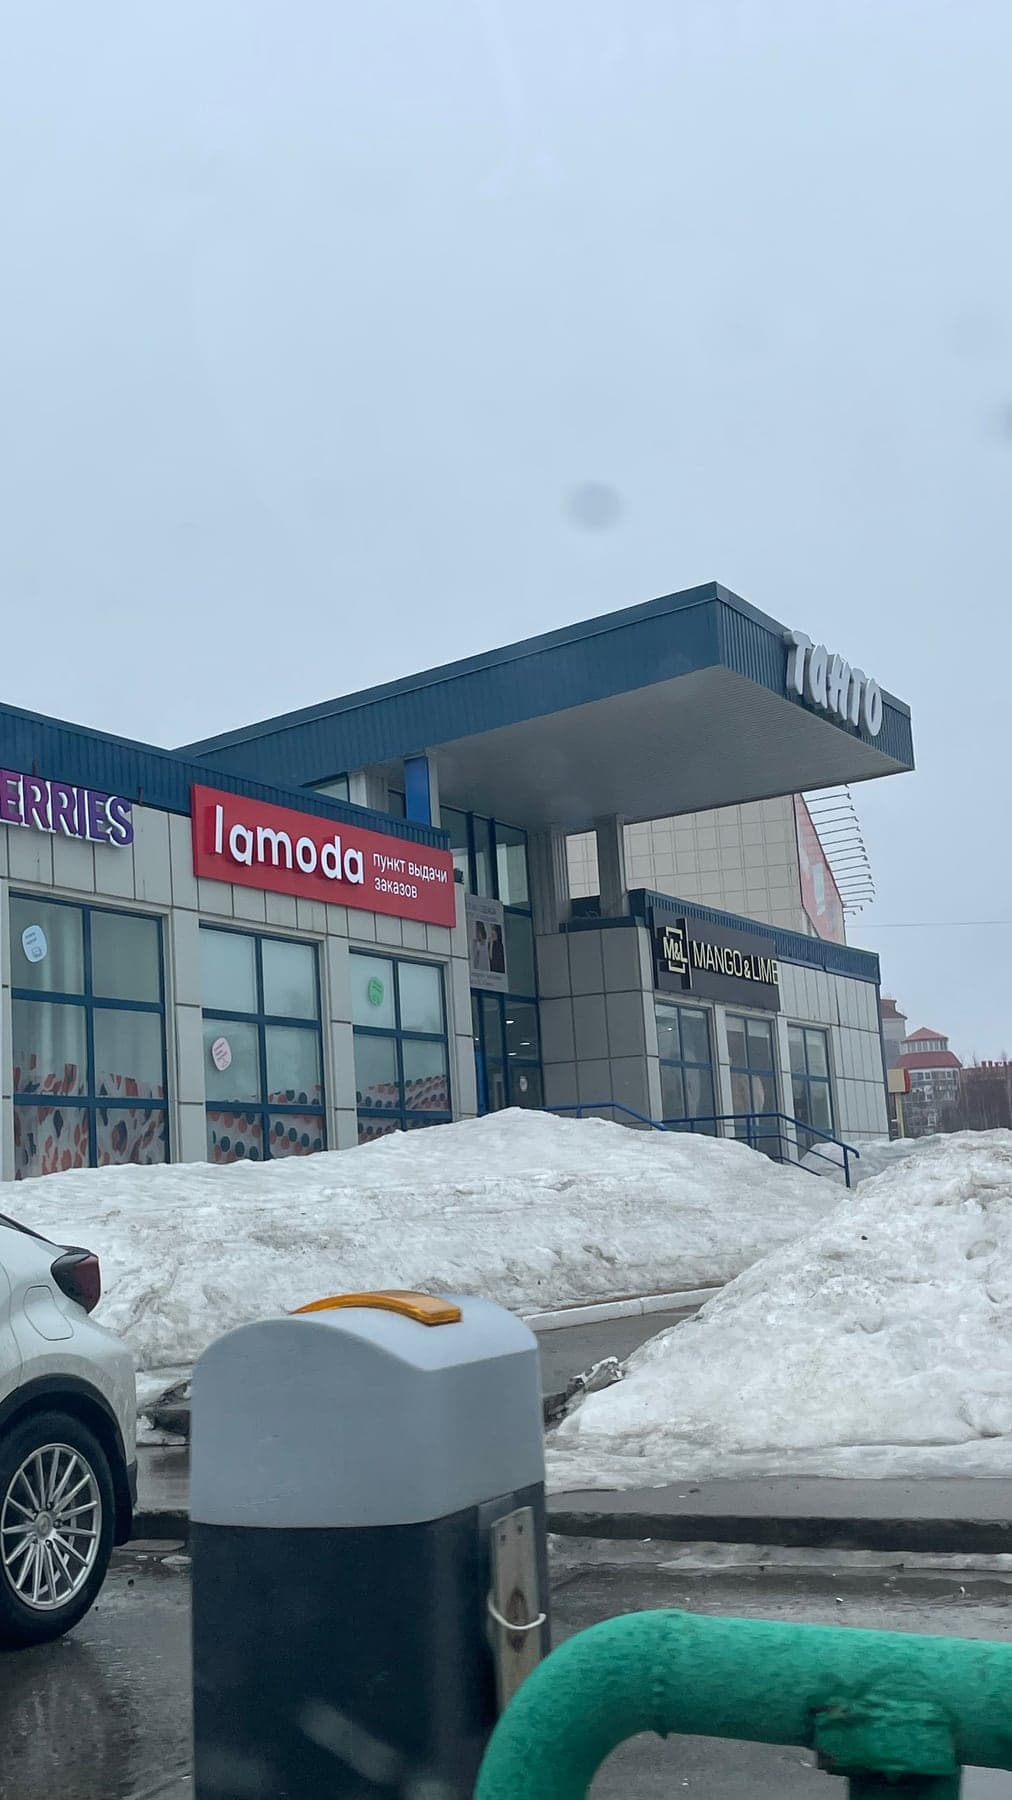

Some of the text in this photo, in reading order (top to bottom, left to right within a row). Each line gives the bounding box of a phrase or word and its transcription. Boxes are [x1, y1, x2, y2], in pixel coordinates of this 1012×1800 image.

[0, 770, 134, 847] ERRIES
[215, 804, 364, 884] lamoda
[373, 853, 448, 883] пункт выдачи
[374, 877, 418, 899] заказов
